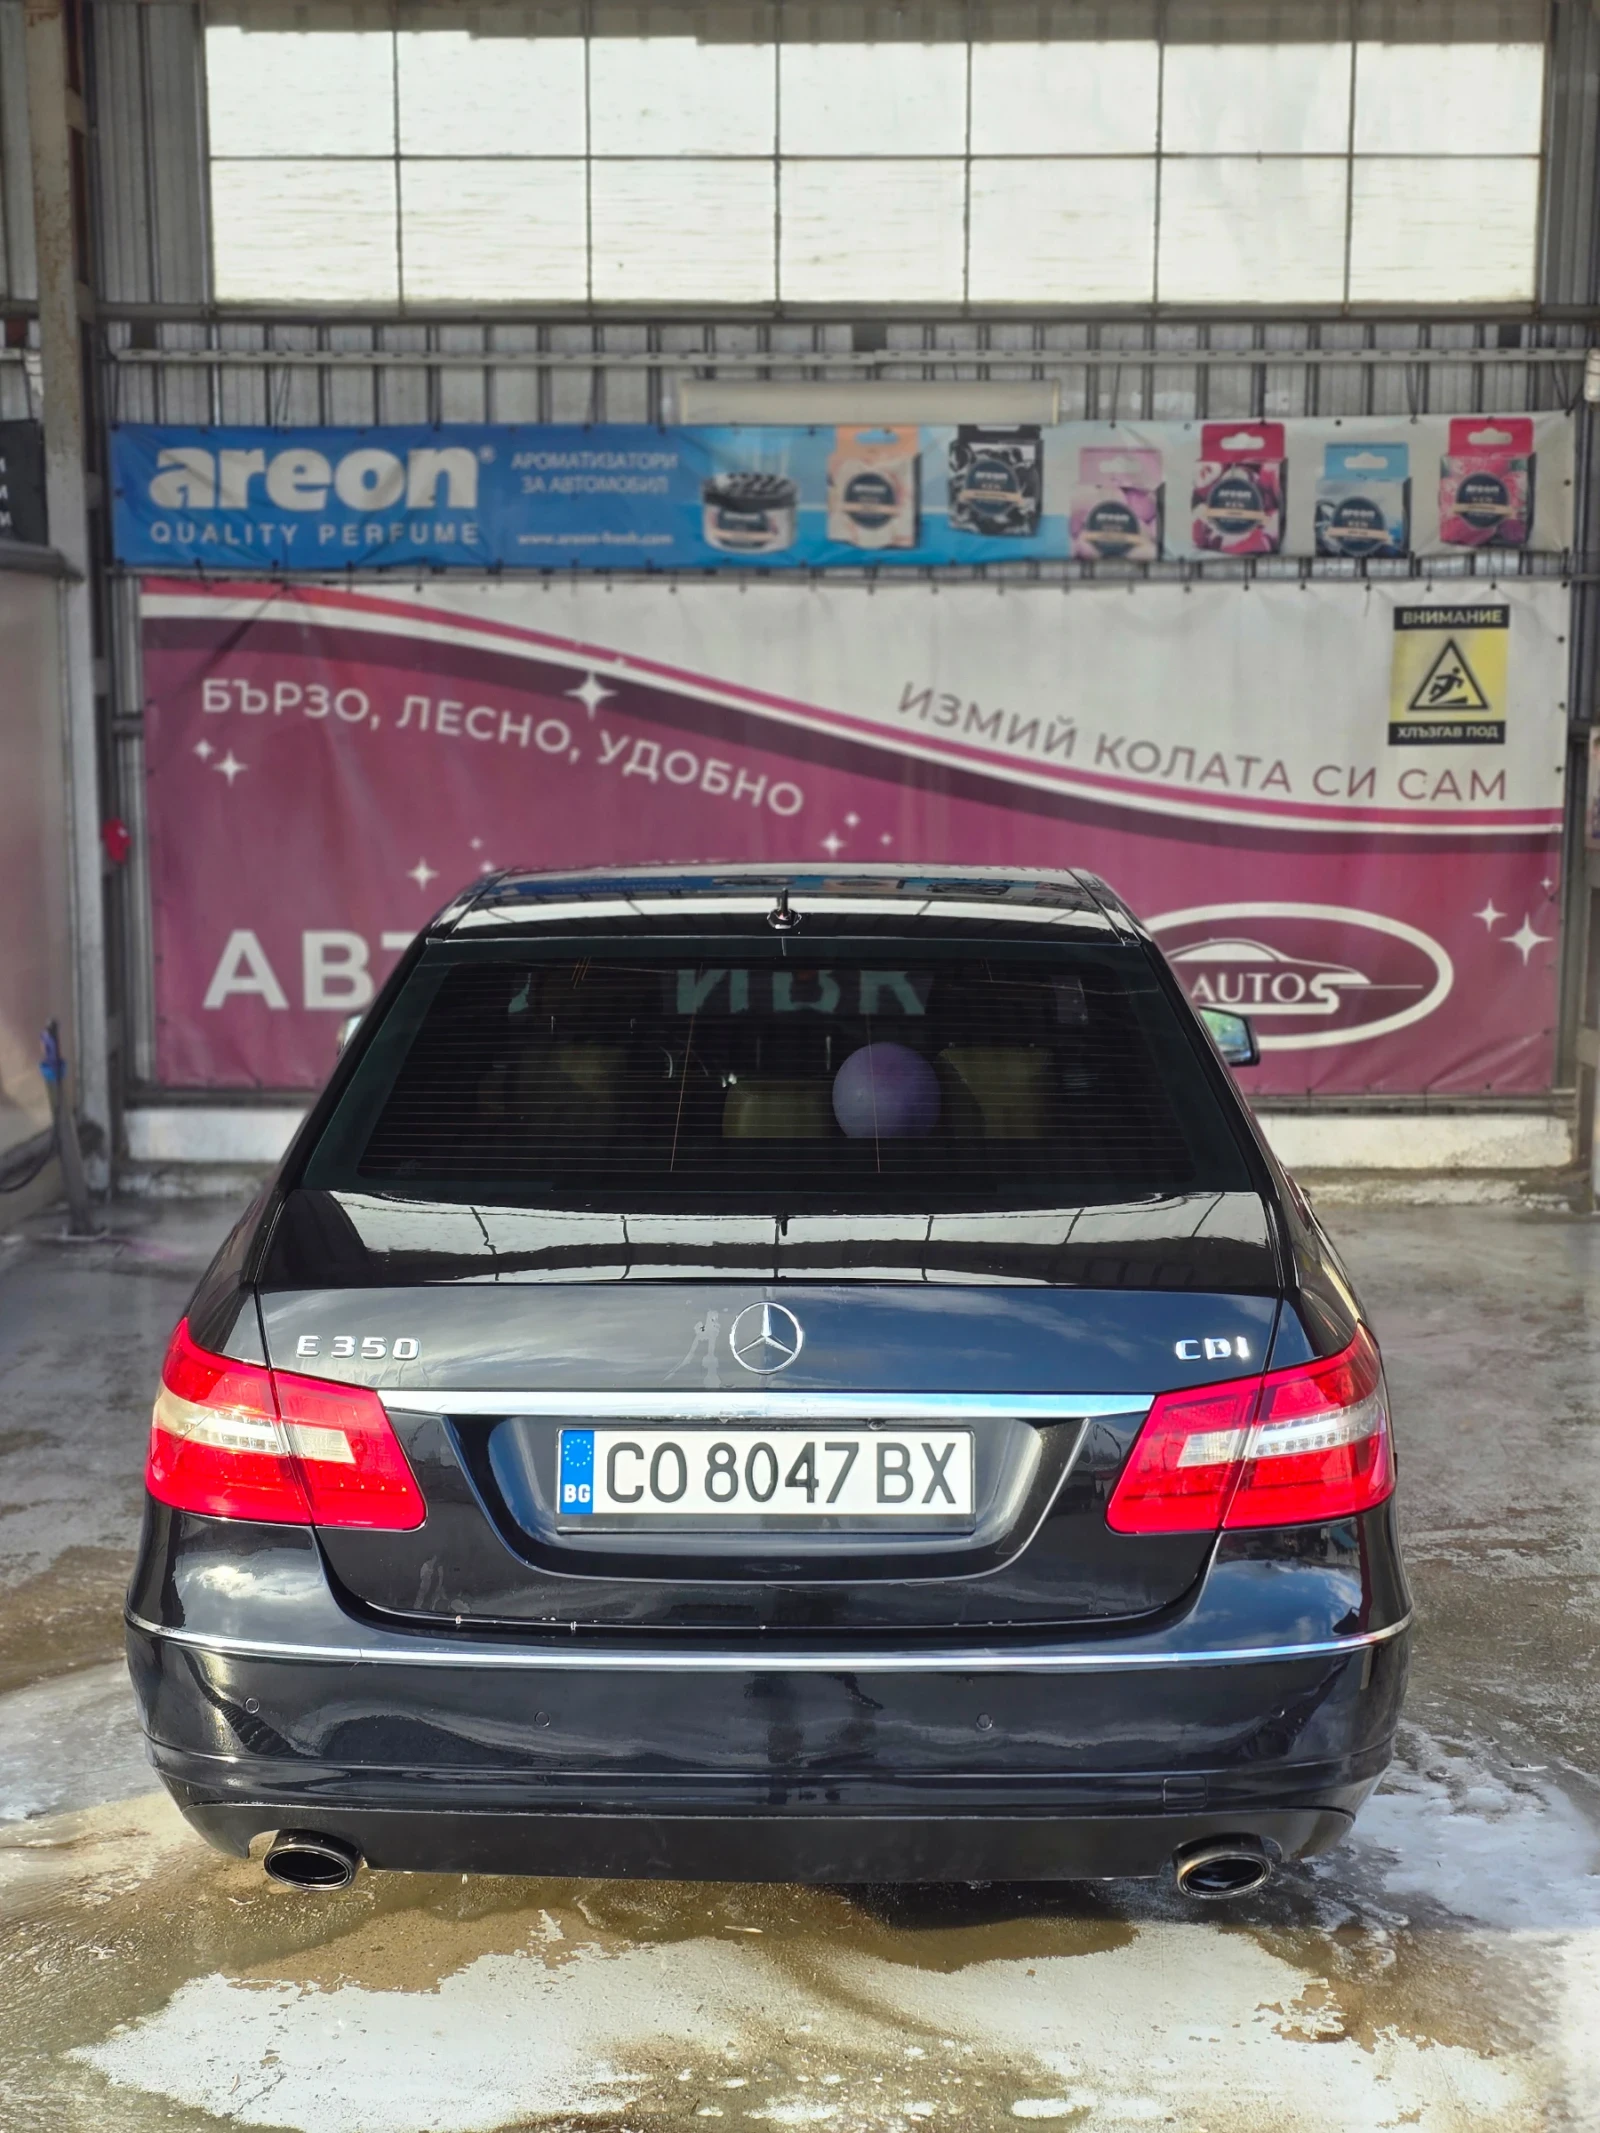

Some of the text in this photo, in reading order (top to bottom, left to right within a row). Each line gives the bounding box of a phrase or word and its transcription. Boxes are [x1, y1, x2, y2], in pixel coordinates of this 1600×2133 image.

[511, 451, 678, 470] АРОМАТИЗАТОРИ
[521, 474, 669, 494] ЗА АВТОМОБИЛ
[150, 522, 479, 545] QUALITY PERFUME
[1401, 610, 1503, 625] ВНИМАНИЕ
[897, 681, 1505, 801] ИЗМИЙ КОЛАТА СИ САМ
[1397, 726, 1499, 738] ХЛЪЗГАВ ПОД
[202, 678, 803, 817] БЪРЗО, ЛЕСНО, УДОБНО
[295, 1334, 421, 1361] E 350
[1175, 1336, 1251, 1361] CDI
[704, 1441, 860, 1503] 8047
[563, 1484, 591, 1504] BG
